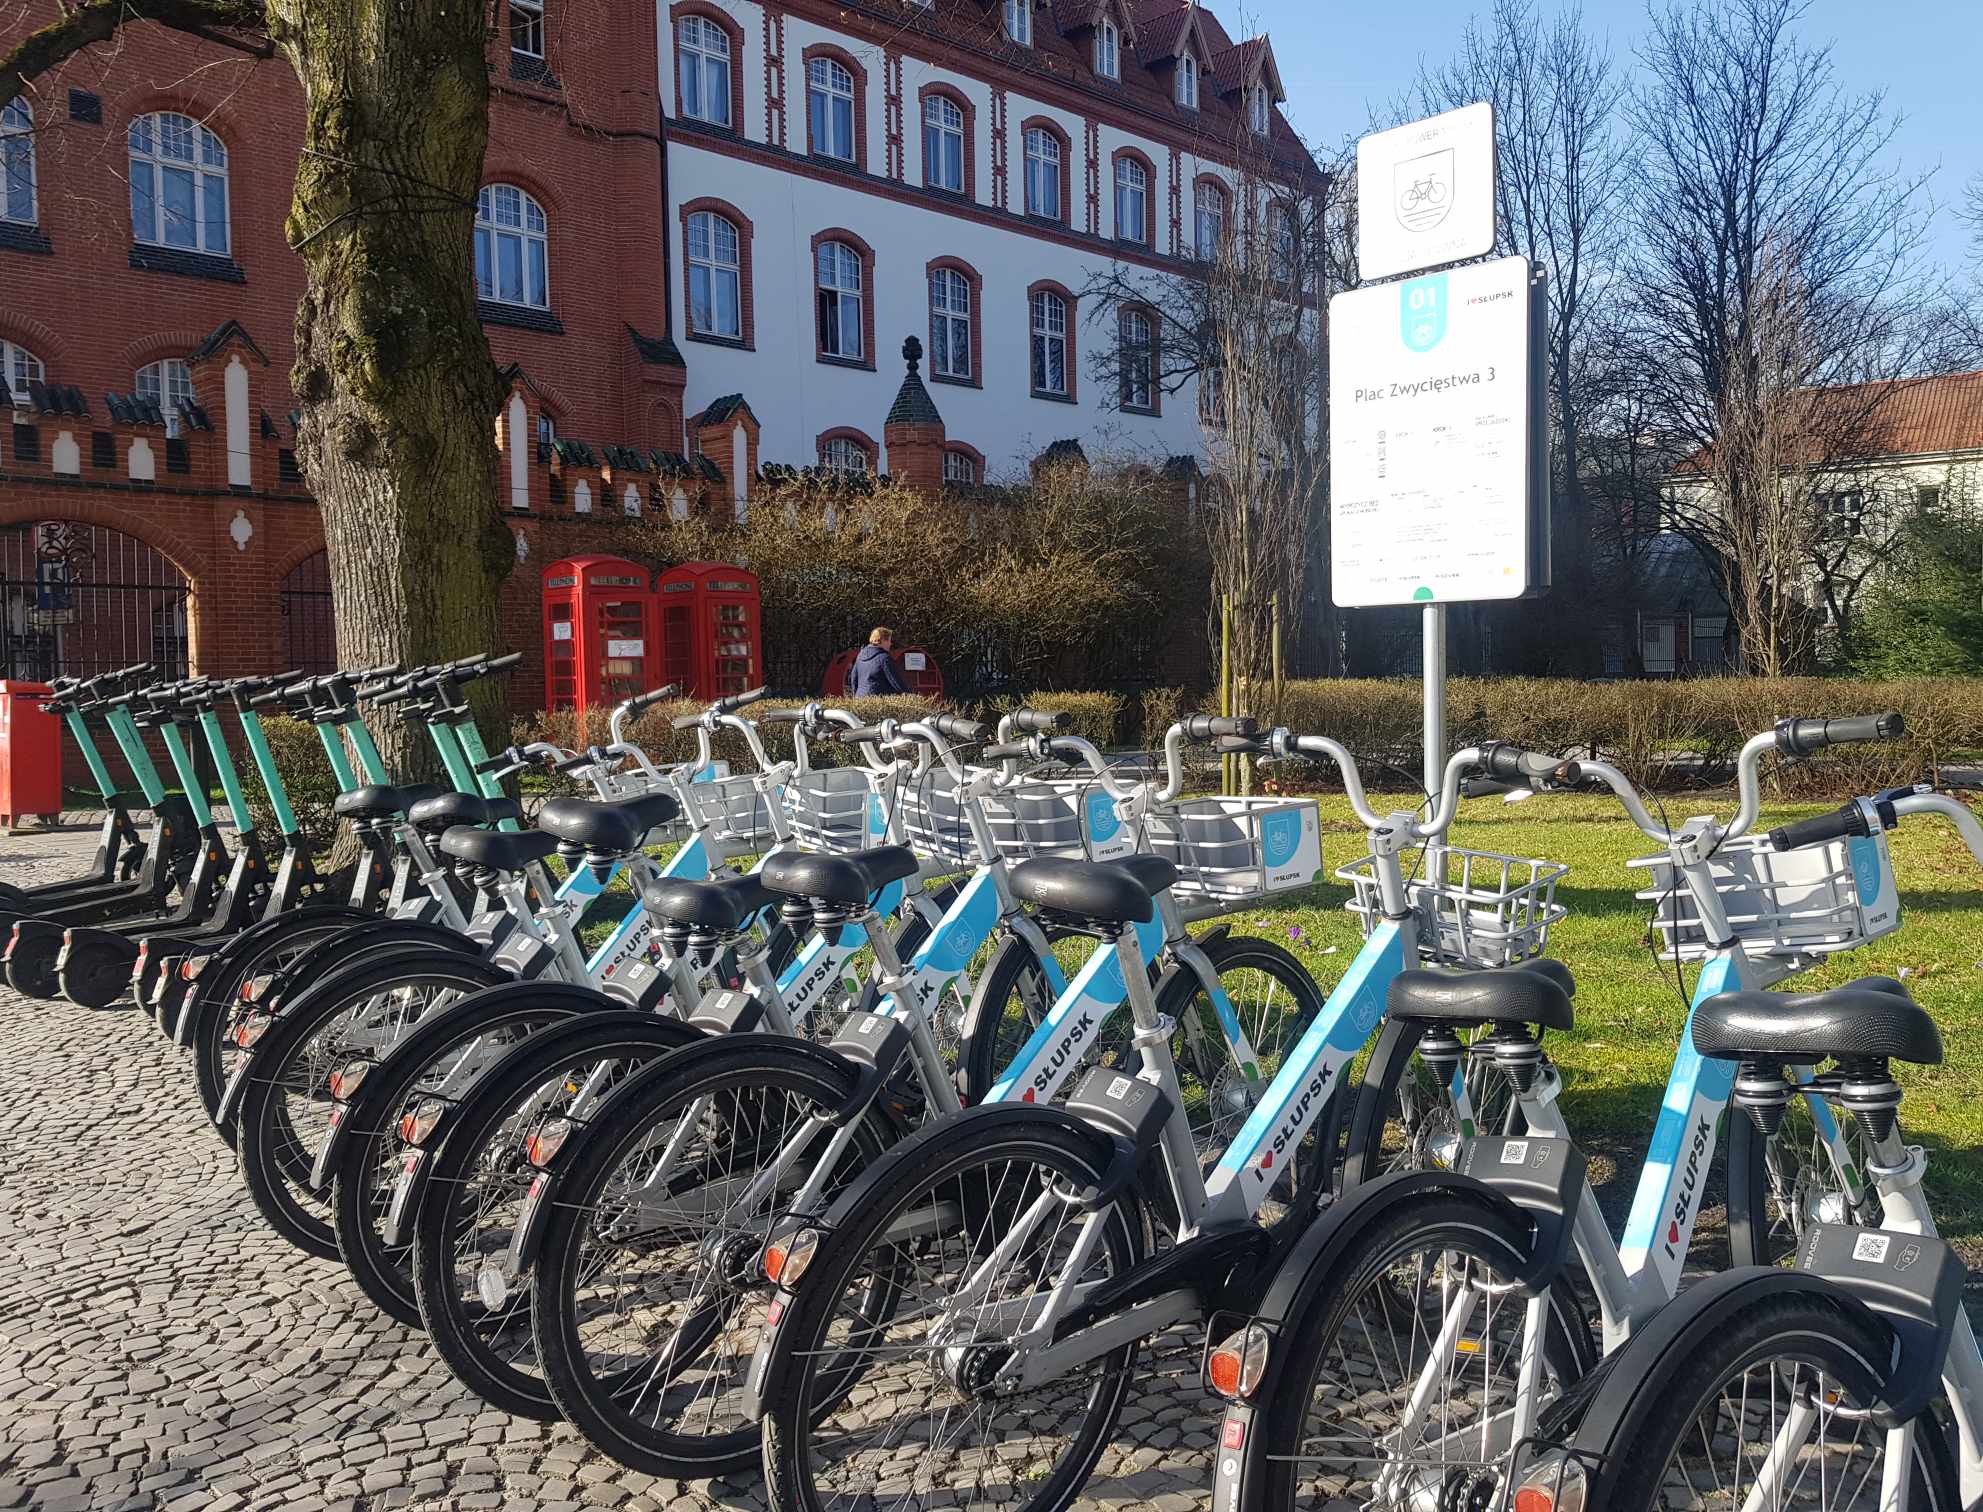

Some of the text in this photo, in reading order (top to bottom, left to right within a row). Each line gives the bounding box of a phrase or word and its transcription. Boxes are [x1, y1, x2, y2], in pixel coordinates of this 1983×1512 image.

[1408, 287, 1437, 310] 01
[1477, 290, 1514, 304] SŁUPSK
[1354, 367, 1496, 404] Plac Zwycięstwa 3
[787, 954, 836, 1016] ŁUPSK
[1034, 1011, 1094, 1093] SŁUPSK
[1254, 1061, 1334, 1184] I SŁUPSK
[1664, 1114, 1712, 1260] I SŁUPSK
